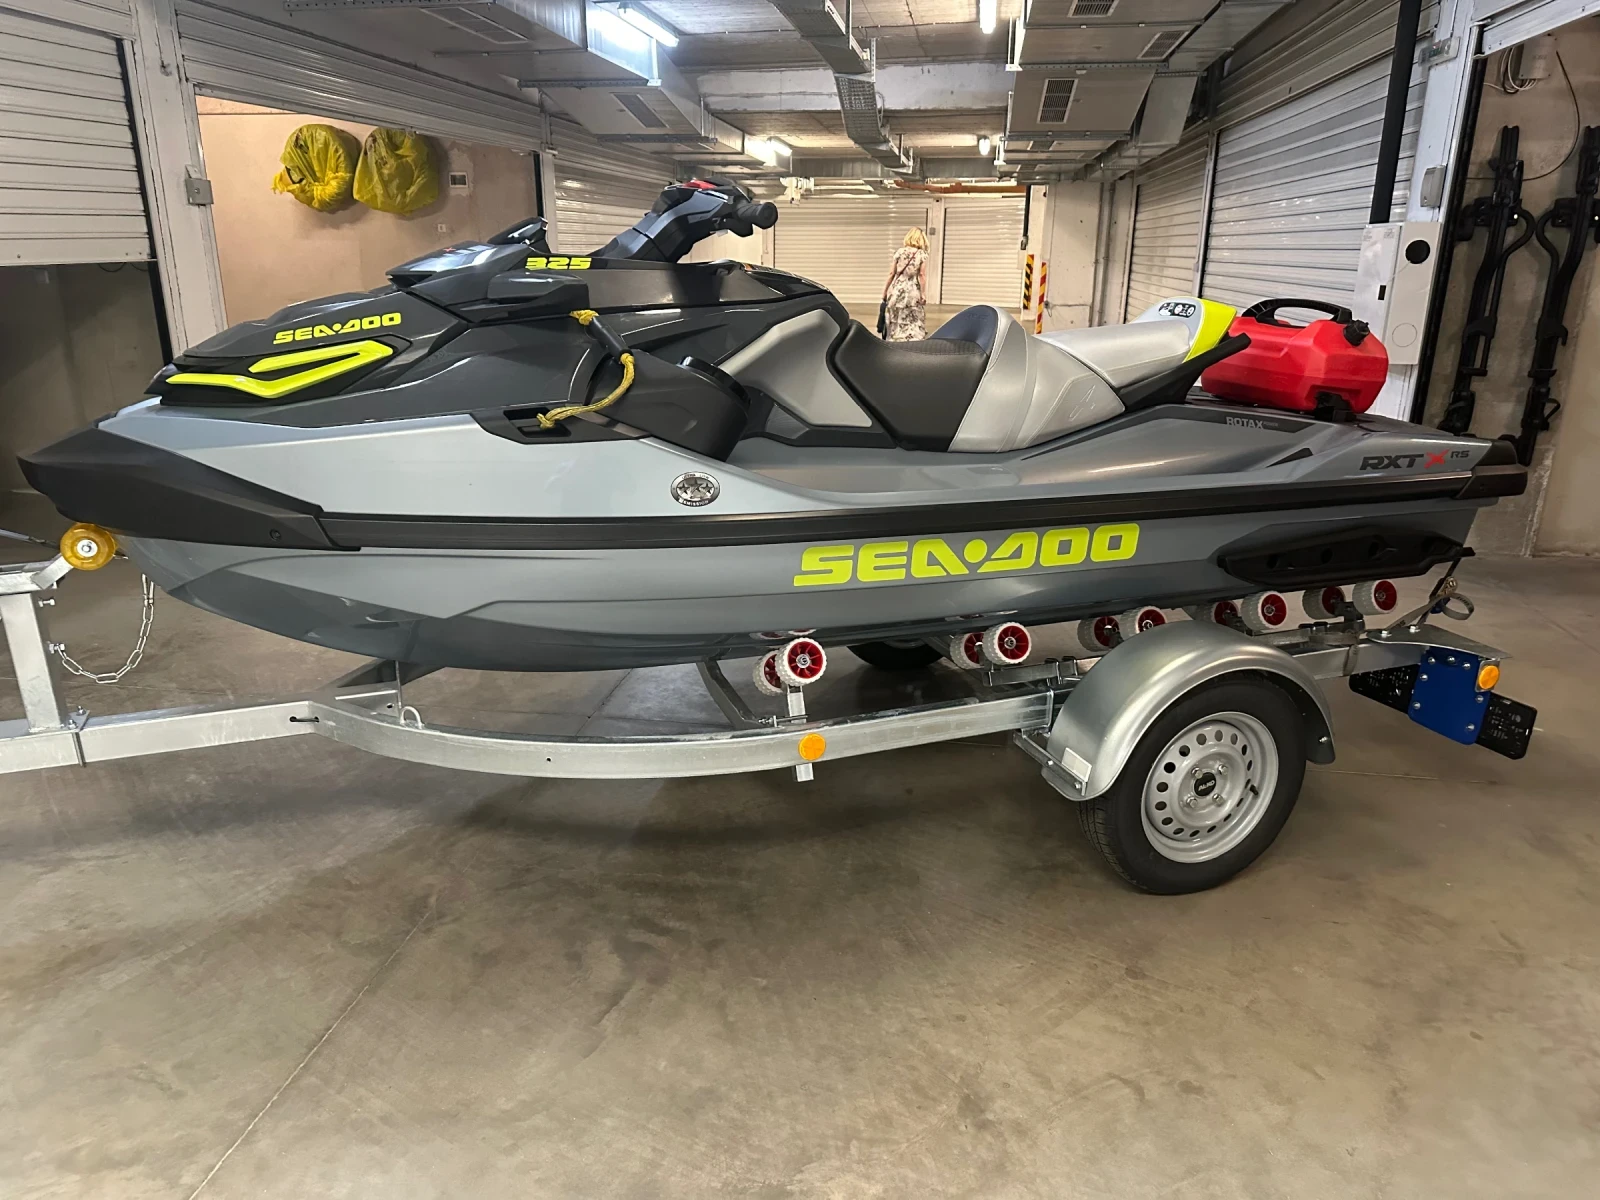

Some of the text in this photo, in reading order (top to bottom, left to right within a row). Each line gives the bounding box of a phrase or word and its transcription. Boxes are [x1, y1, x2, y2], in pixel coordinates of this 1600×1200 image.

[525, 257, 592, 270] 325
[1226, 416, 1264, 430] ROTAX
[1359, 453, 1425, 470] RXT
[1450, 450, 1470, 459] RS
